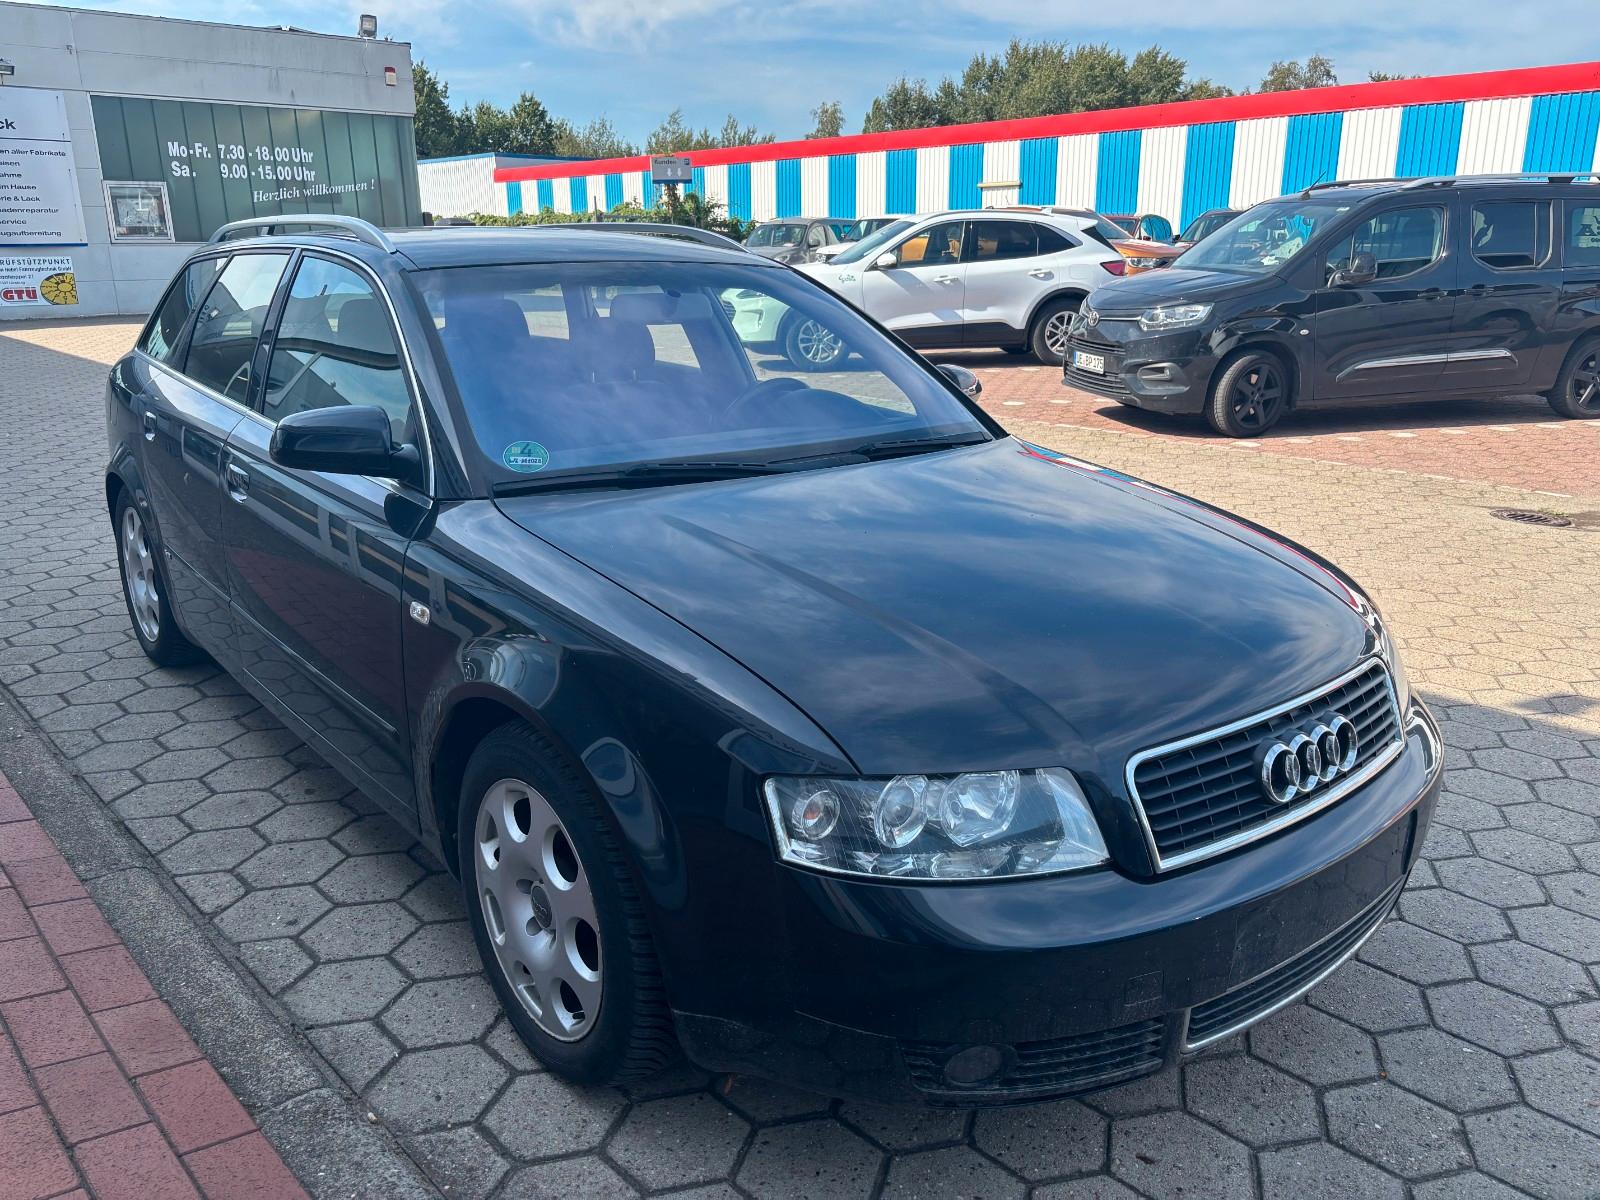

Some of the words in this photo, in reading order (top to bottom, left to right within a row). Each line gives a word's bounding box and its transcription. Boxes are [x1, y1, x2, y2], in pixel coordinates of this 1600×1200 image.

[29, 149, 66, 157] Fabrikate
[217, 144, 245, 160] 7.30
[255, 145, 290, 162] 18.00
[291, 147, 314, 163] Uhr
[171, 160, 196, 177] Sa.
[220, 163, 247, 180] 9.00
[258, 164, 291, 181] 15.00
[293, 166, 315, 182] Uhr
[253, 186, 300, 203] Herzlich
[302, 181, 368, 197] willkommen
[3, 287, 38, 300] GTÜ
[519, 442, 534, 458] 4
